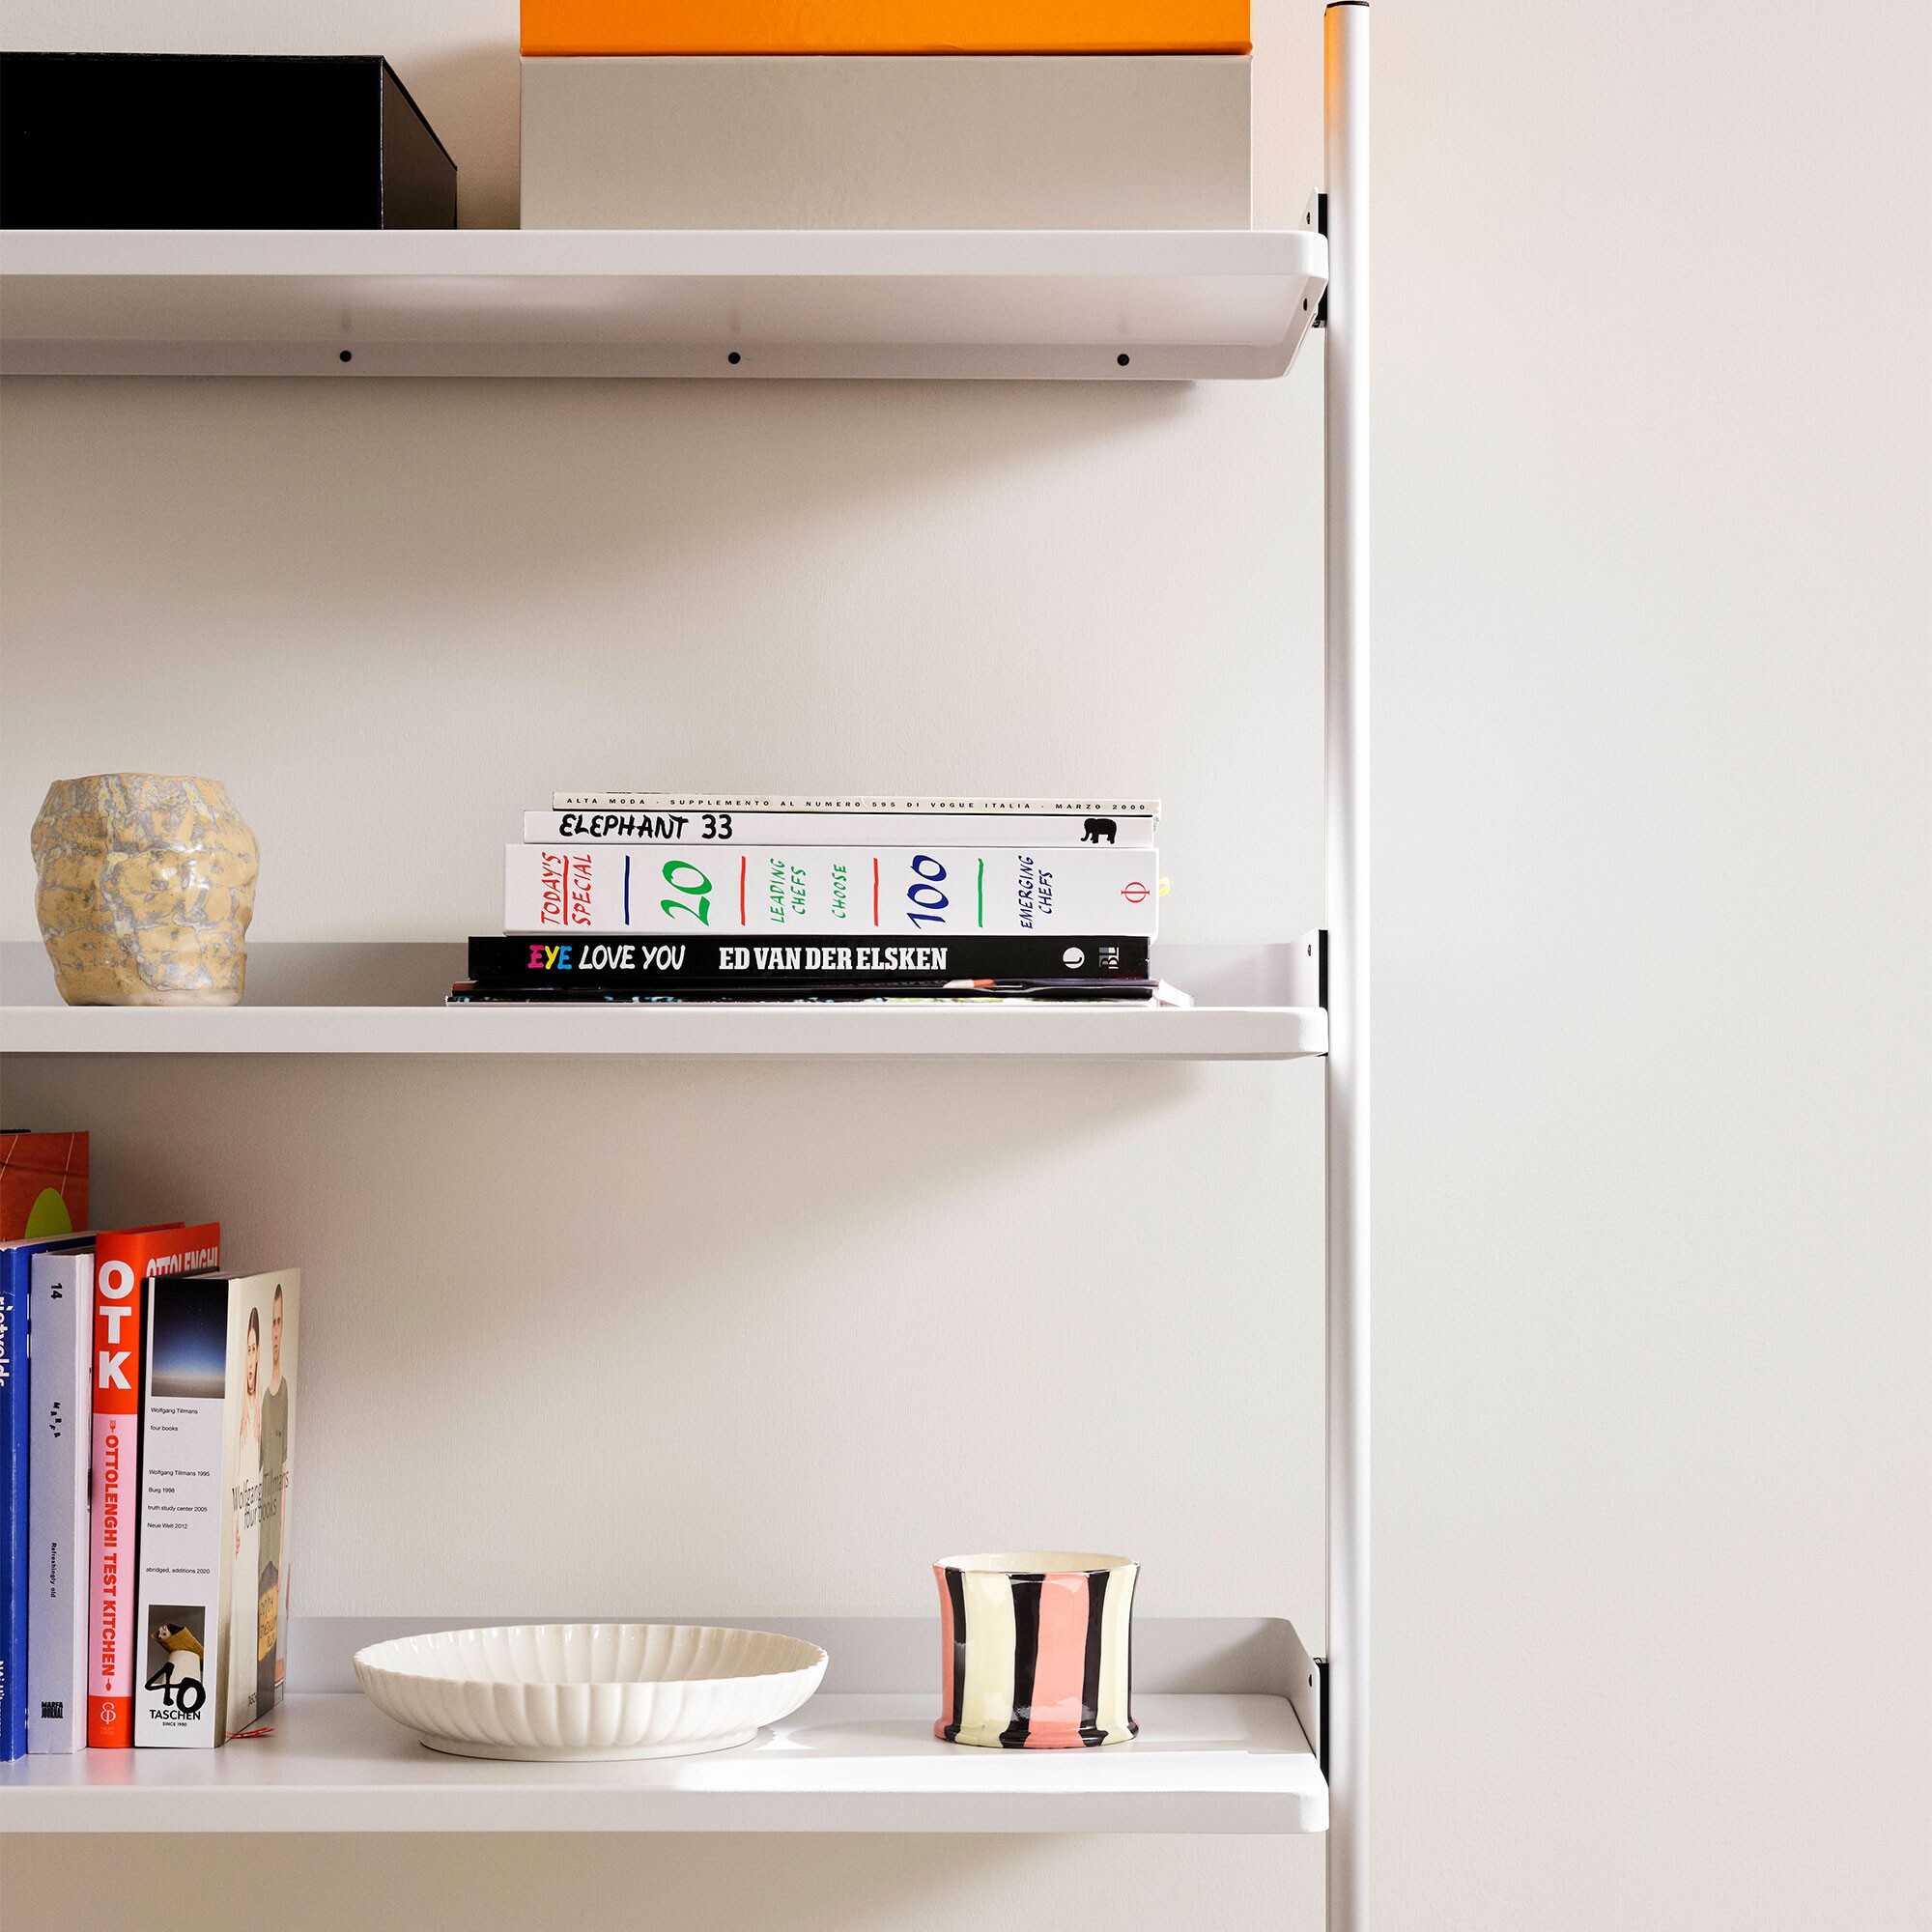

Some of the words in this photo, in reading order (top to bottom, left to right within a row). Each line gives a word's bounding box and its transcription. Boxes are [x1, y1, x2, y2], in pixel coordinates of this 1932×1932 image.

[559, 814, 689, 838] ELEPHANT
[701, 814, 732, 839] 33
[541, 852, 561, 924] TODAY'S
[572, 855, 591, 925] SPECIAL
[661, 861, 712, 925] 20
[770, 859, 785, 923] LEADING
[791, 867, 806, 914] CHEFS
[832, 865, 846, 918] CHOOSE
[907, 855, 949, 929] 100
[1020, 856, 1034, 929] EMERGING
[1038, 869, 1052, 914] CHEFS
[527, 945, 572, 970] EYE
[579, 945, 635, 970] LOVE
[642, 945, 686, 970] YOU
[719, 948, 750, 969] ED
[753, 948, 802, 969] VAN
[806, 948, 852, 970] DER
[856, 948, 948, 970] ELSKEN
[51, 1283, 62, 1299] 14
[99, 1261, 134, 1389] OTK
[150, 1406, 176, 1415] Wolfgang
[104, 1435, 119, 1548] OTTOLENGHI
[49, 1542, 58, 1585] Refreshingly
[103, 1552, 117, 1597] TEST
[101, 1600, 117, 1676] KITCHEN
[145, 1662, 206, 1714] 40
[150, 1709, 201, 1720] TASCHEN
